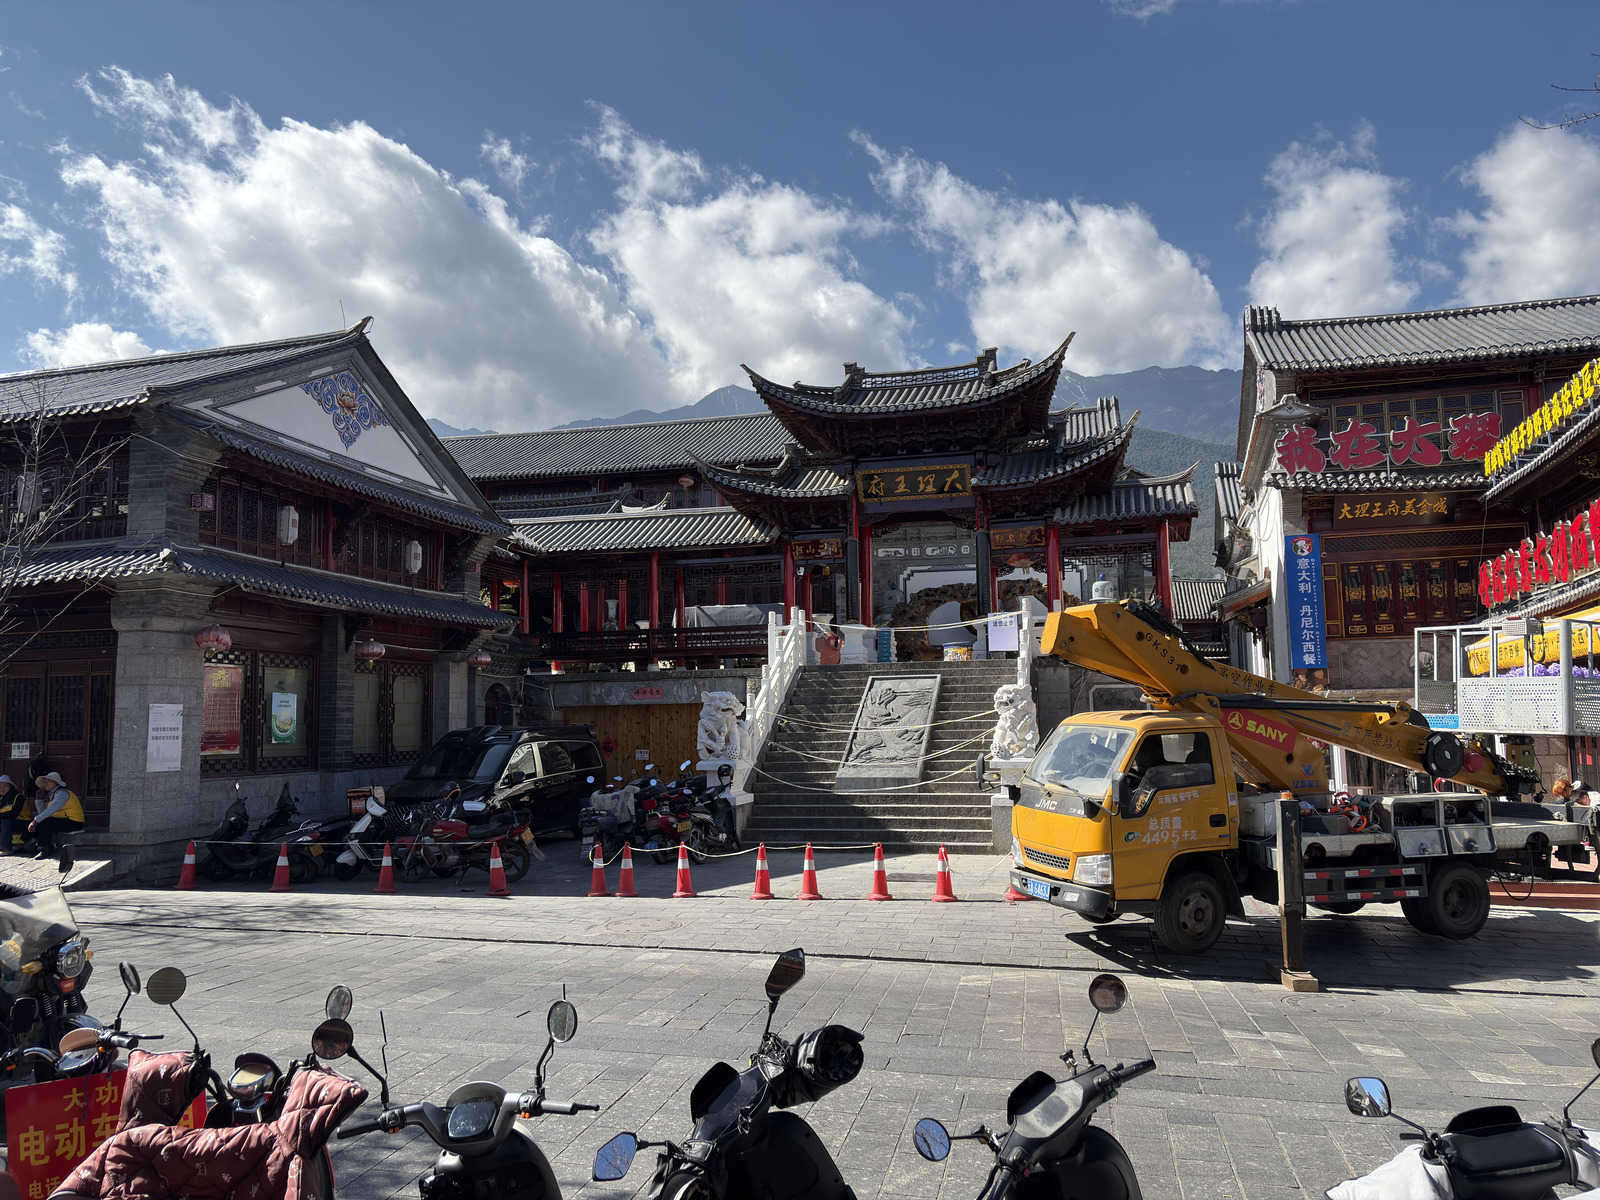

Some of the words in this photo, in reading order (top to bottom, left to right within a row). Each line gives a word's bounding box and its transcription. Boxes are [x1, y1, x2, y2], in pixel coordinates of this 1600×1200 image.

[1275, 411, 1502, 476] 我在大理
[1338, 497, 1449, 520] 大理王府美食城
[1219, 666, 1276, 695] 高空作业车
[1246, 719, 1288, 743] SANY
[1035, 799, 1058, 811] JMC
[1148, 816, 1182, 831] 总质量
